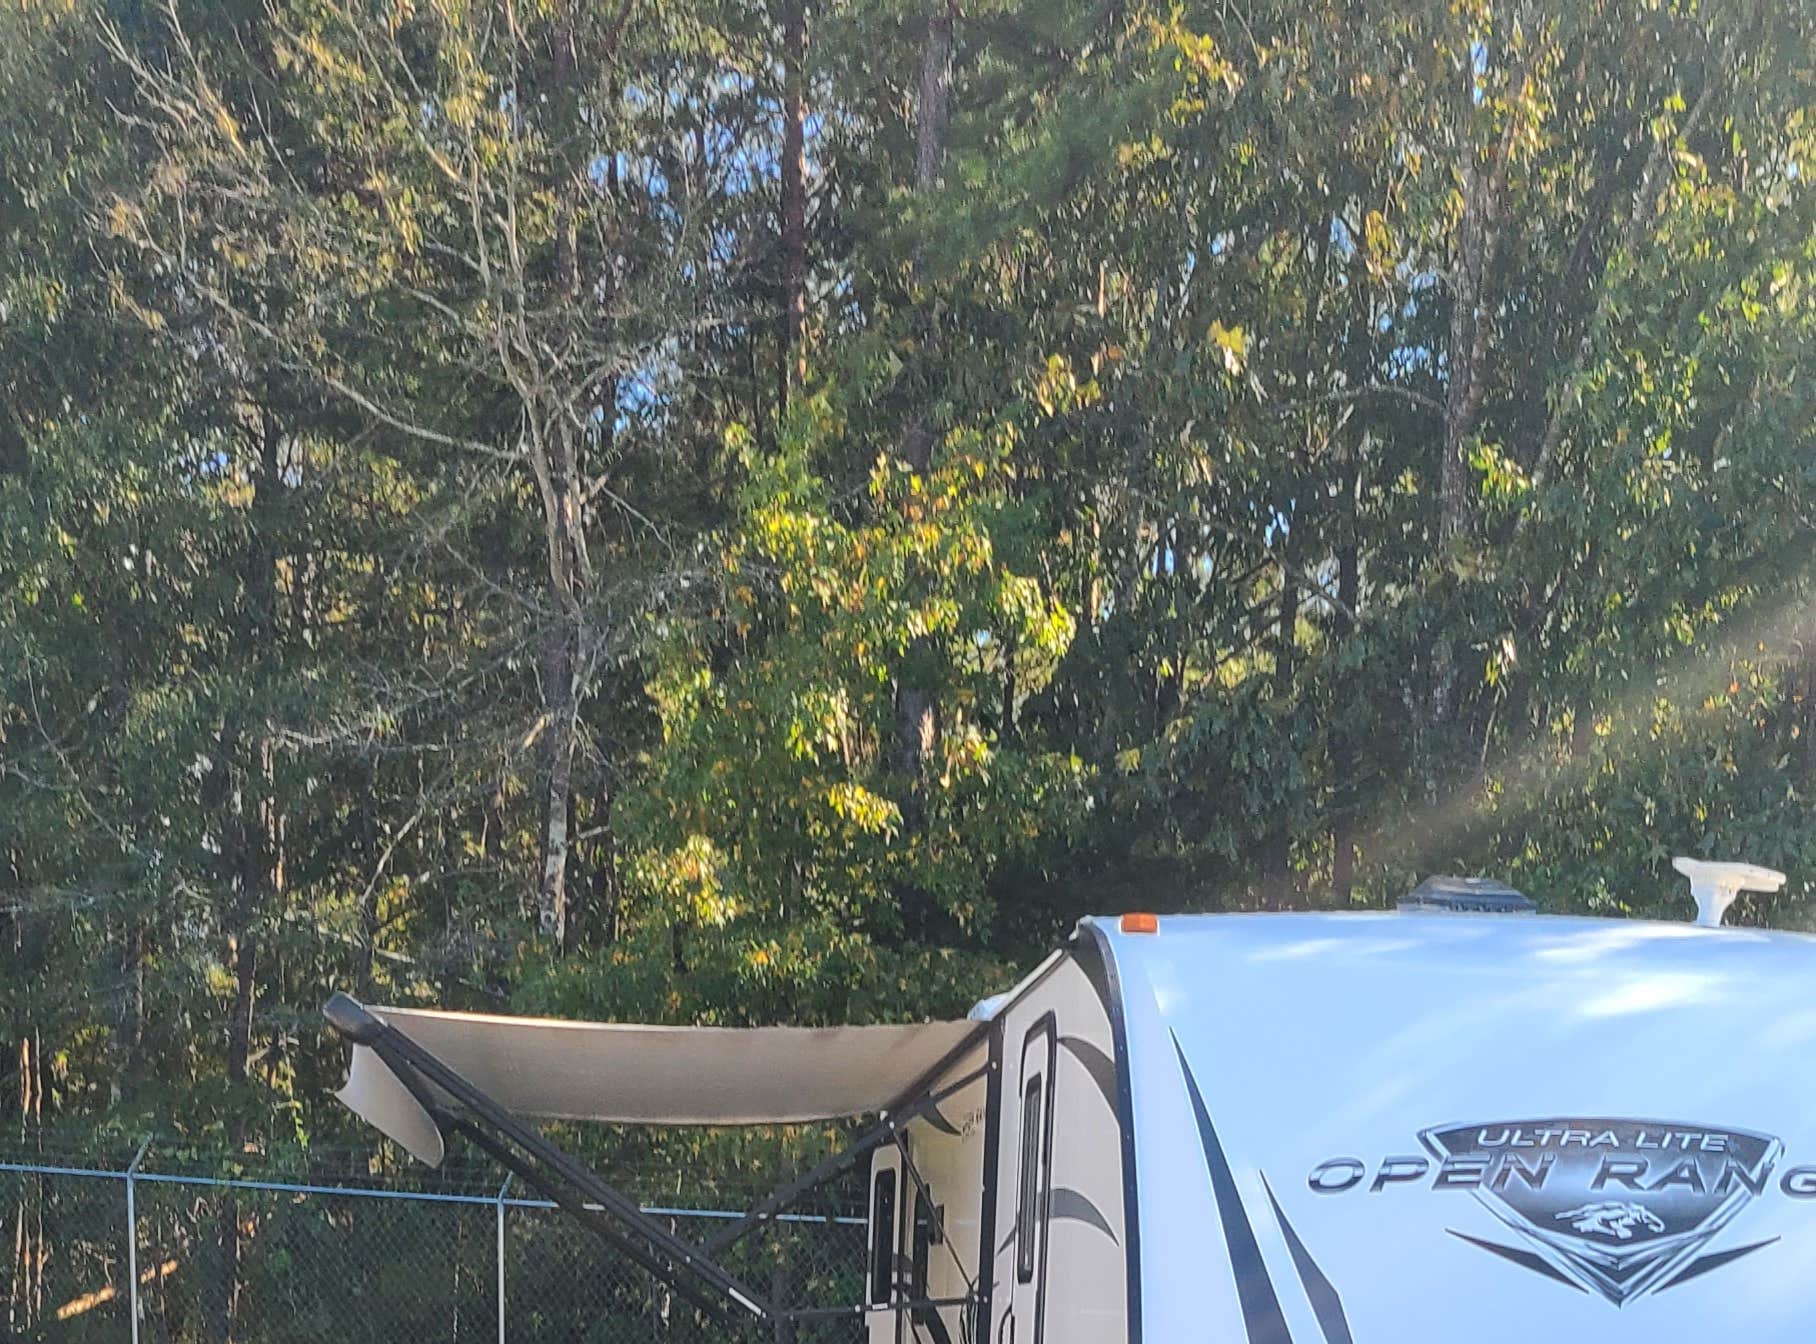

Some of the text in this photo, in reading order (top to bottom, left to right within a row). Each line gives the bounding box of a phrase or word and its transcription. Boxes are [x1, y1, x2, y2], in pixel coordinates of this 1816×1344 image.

[1478, 1128, 1729, 1151] ULTRA LITE
[1308, 1153, 1557, 1194] OPEN
